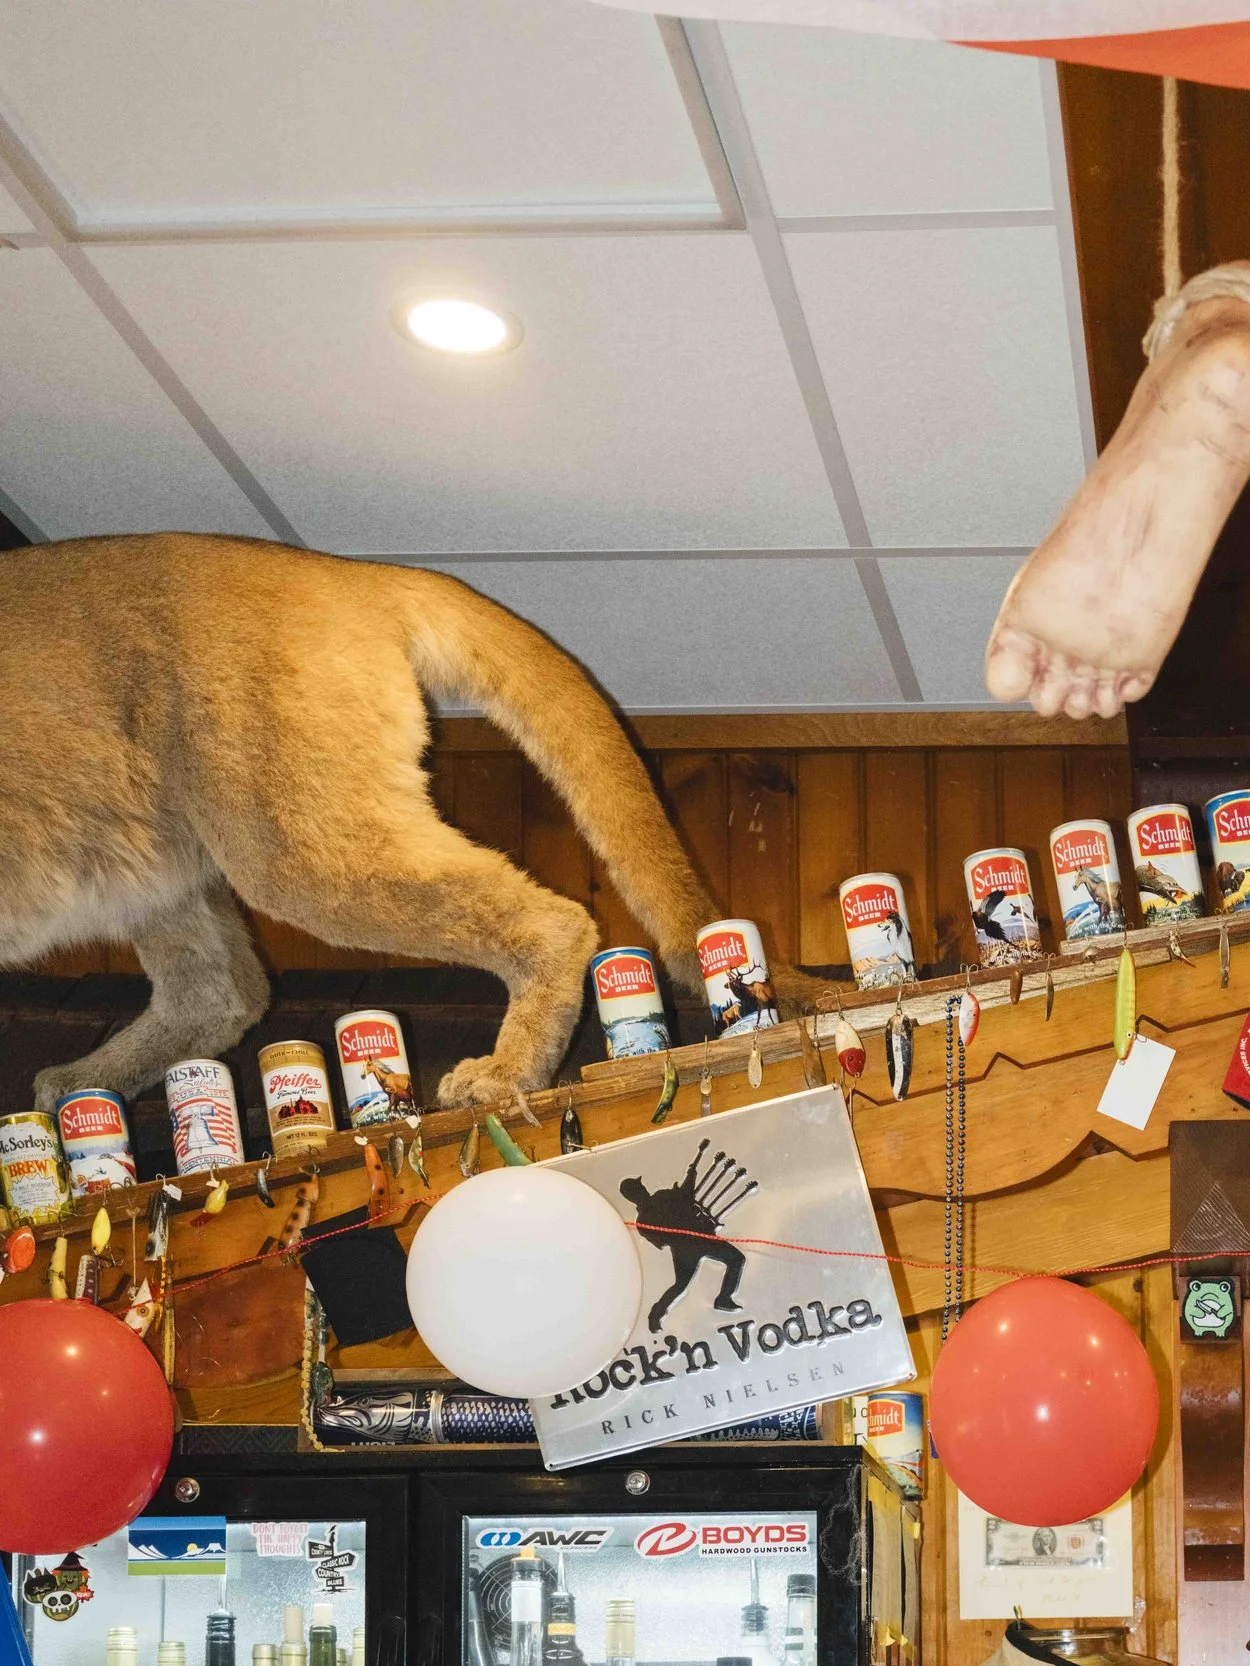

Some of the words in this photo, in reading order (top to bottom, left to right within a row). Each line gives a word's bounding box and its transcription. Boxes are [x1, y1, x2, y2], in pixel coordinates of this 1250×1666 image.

[1140, 819, 1192, 849] Schmidt
[1158, 840, 1181, 849] BEER
[1055, 839, 1106, 868] Schmidt
[1069, 858, 1092, 866] BEER
[974, 864, 1027, 893] Schmidt
[991, 884, 1014, 892] BEER
[844, 890, 896, 922] Schmidt
[858, 911, 881, 921] BEER
[708, 960, 728, 971] BEER
[599, 966, 652, 994] Schmidt
[615, 984, 639, 993] BEER
[341, 1028, 397, 1057] Schmidt
[269, 1072, 322, 1094] Pfeiffer
[277, 1089, 300, 1099] Famous
[301, 1088, 316, 1096] Beer
[62, 1103, 120, 1134] Schmidt
[9, 1160, 49, 1178] BREW
[718, 1299, 883, 1363] Vodka
[600, 1403, 679, 1435] RICK
[704, 1363, 845, 1410] NIELSEN
[253, 1524, 275, 1534] DONT
[702, 1525, 807, 1544] BOYDS
[518, 1530, 607, 1547] AWC
[260, 1544, 299, 1554] THOUGHTS
[322, 1559, 337, 1567] CLASSIC
[338, 1555, 350, 1565] ROCK
[318, 1569, 341, 1577] COUNTRY
